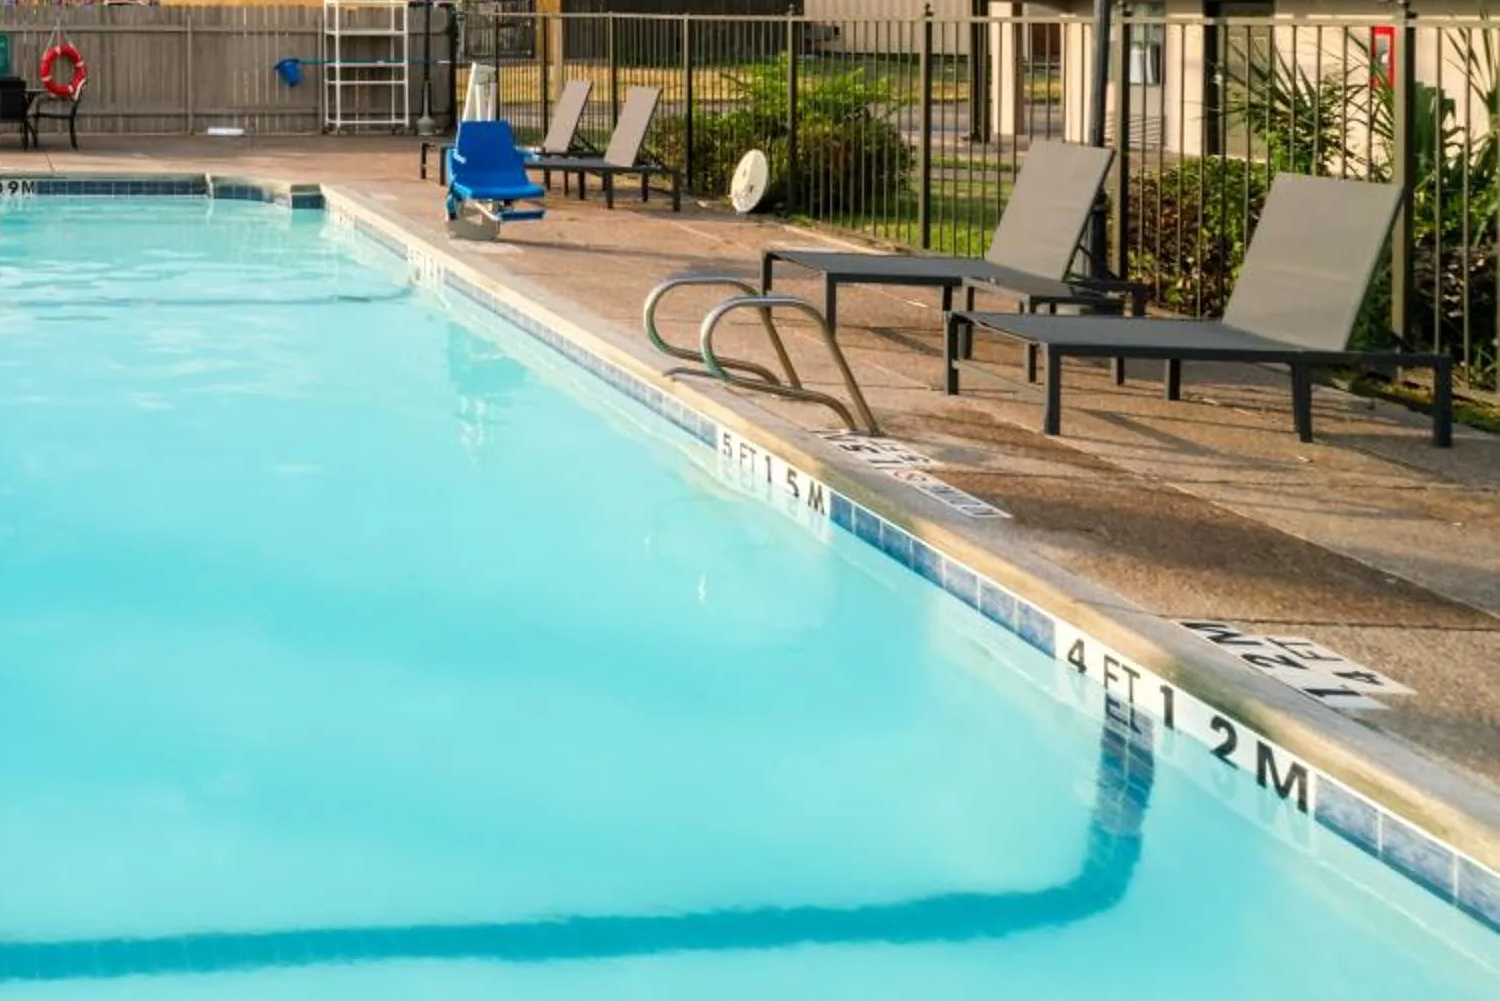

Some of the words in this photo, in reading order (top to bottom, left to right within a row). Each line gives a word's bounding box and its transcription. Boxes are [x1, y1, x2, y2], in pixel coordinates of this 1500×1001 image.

[739, 442, 757, 474] FT
[1066, 637, 1088, 674] 4
[1103, 654, 1141, 704] FT
